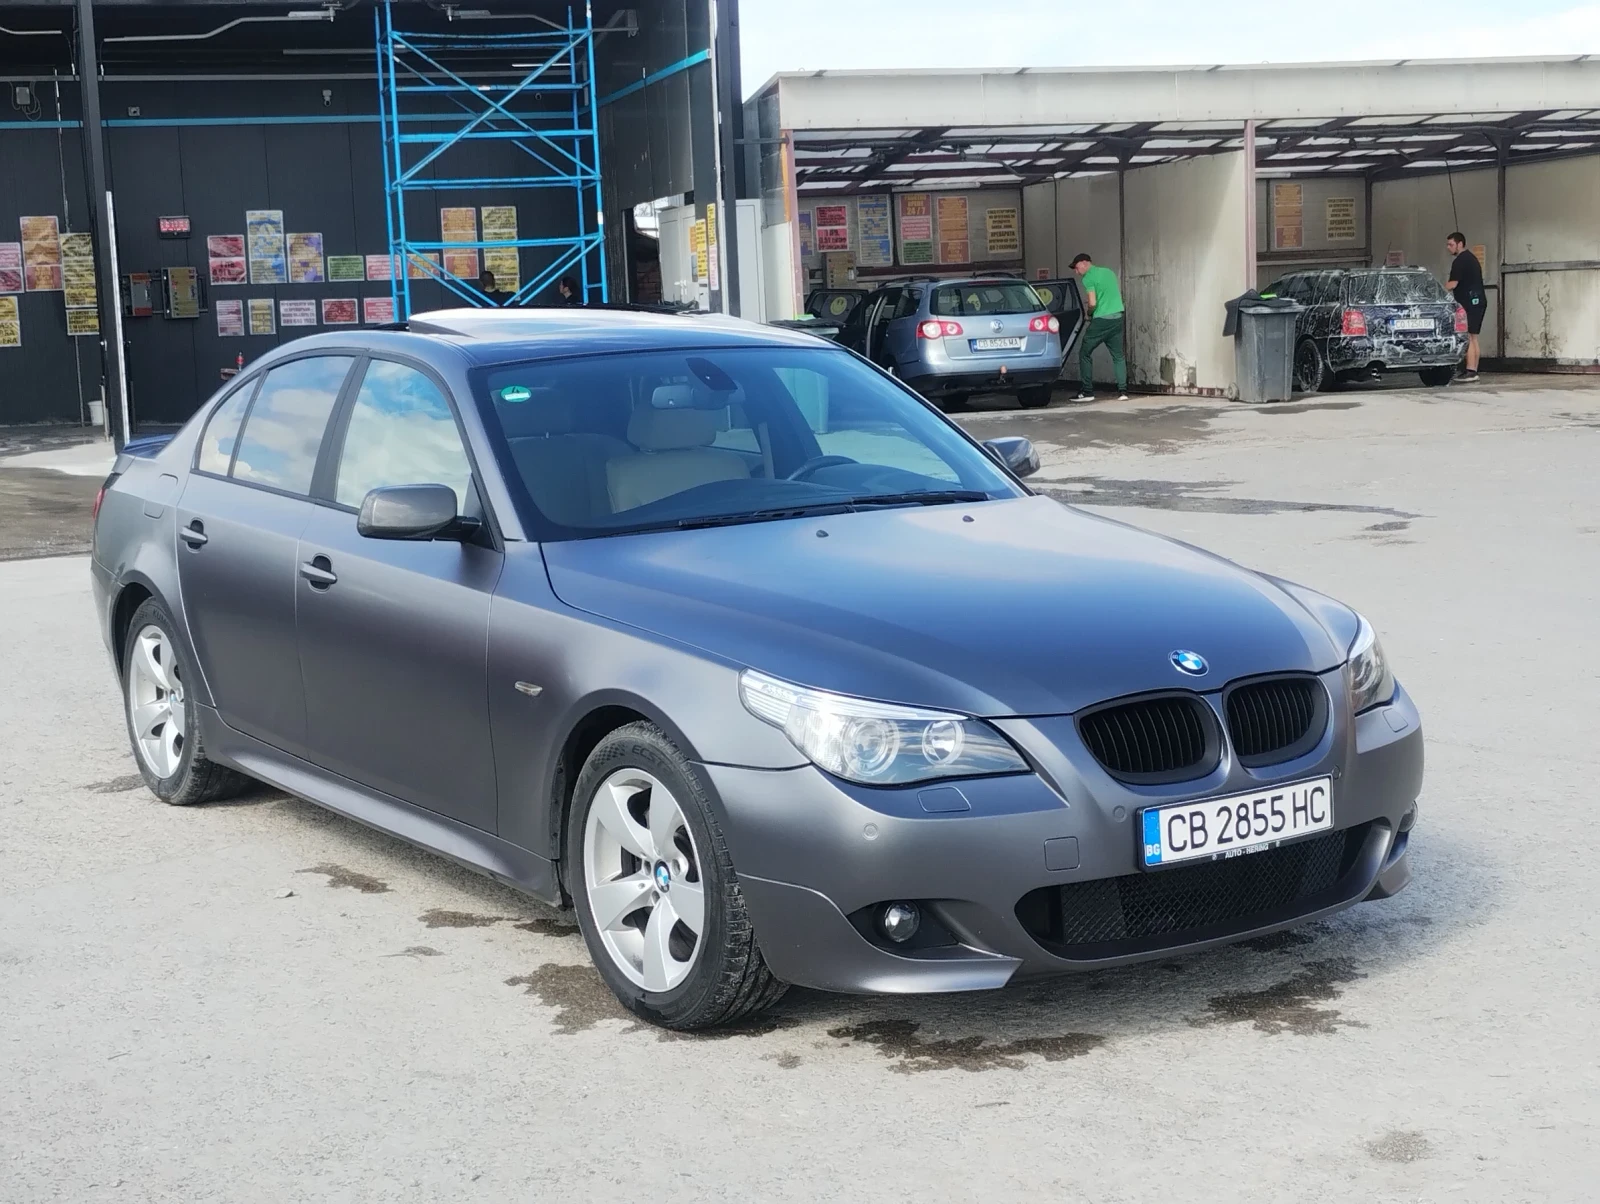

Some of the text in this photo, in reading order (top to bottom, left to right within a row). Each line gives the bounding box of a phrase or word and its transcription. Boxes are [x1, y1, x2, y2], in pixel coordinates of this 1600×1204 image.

[978, 339, 988, 348] CB
[1166, 786, 1326, 852] CB 2855 HC
[1145, 843, 1160, 857] BG
